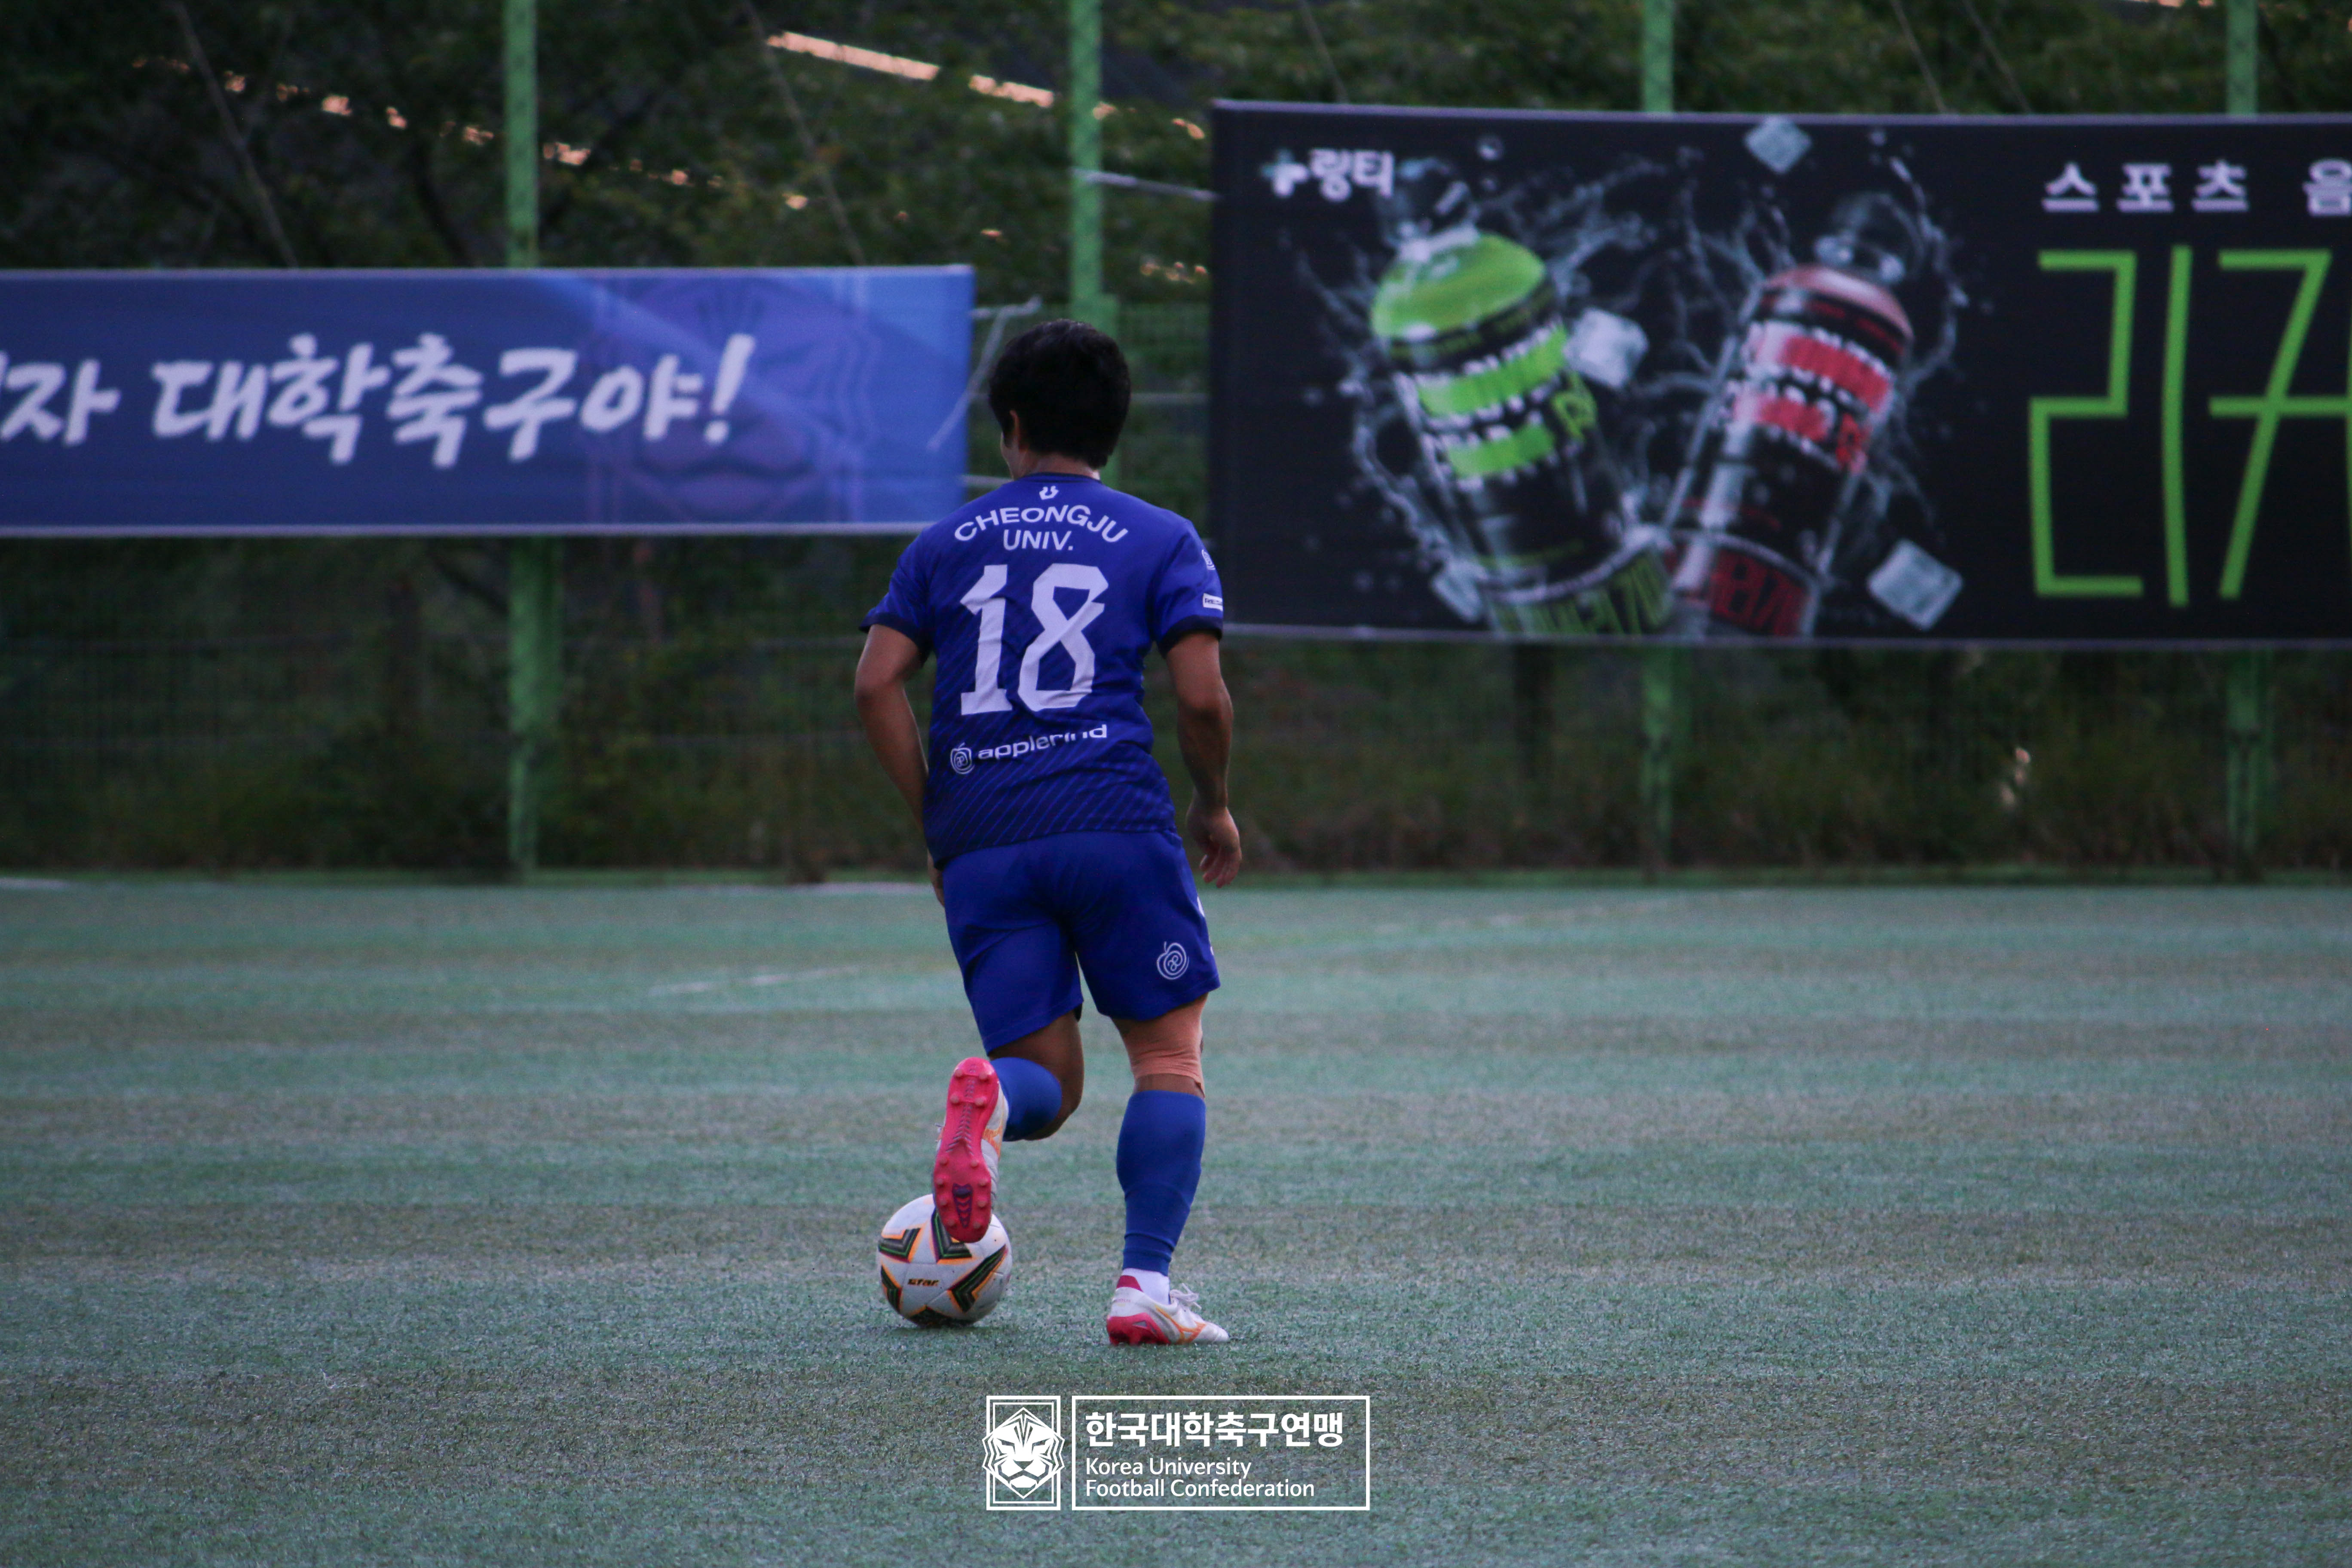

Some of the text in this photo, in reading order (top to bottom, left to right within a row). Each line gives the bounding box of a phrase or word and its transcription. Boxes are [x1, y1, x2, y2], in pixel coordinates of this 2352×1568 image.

[2042, 161, 2248, 212] 스포츠
[0, 332, 757, 468] 자 대학축구야!
[954, 505, 1128, 542] CHEONGJU
[1003, 529, 1074, 551] UNIV.
[960, 563, 1109, 715] 18
